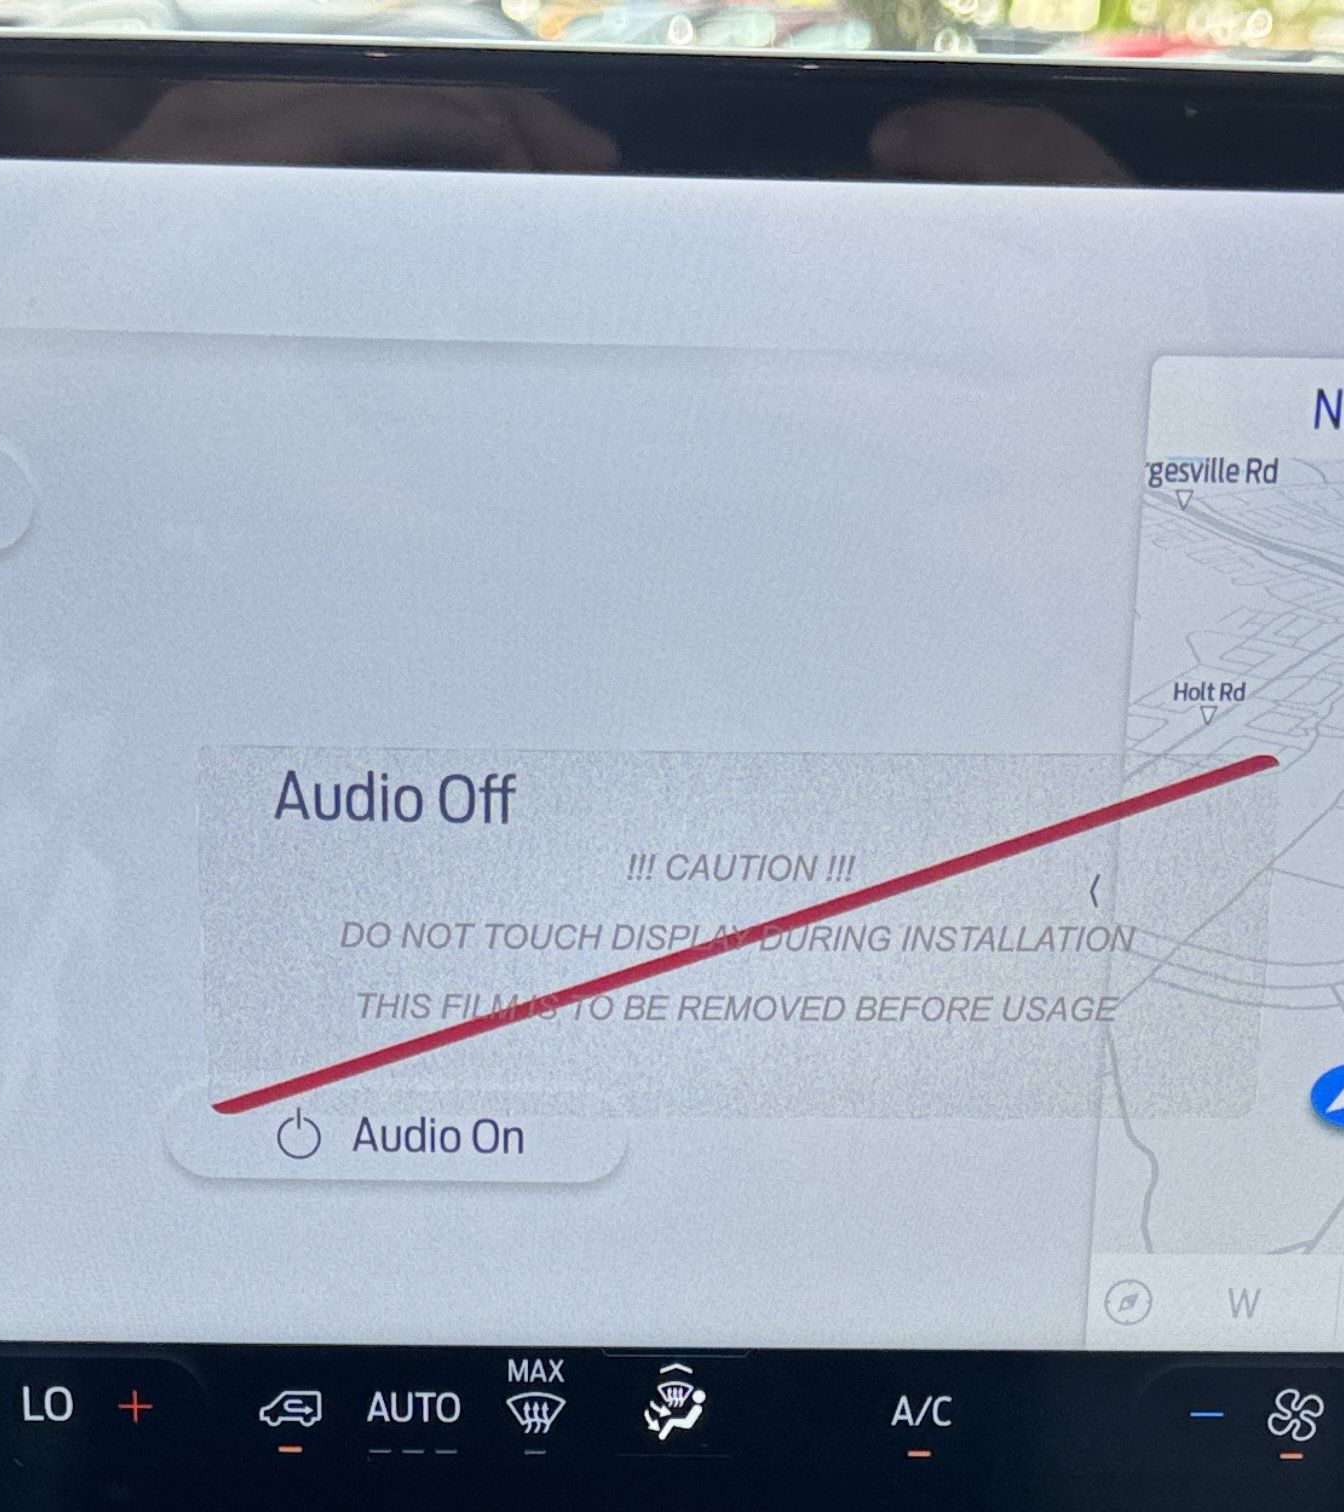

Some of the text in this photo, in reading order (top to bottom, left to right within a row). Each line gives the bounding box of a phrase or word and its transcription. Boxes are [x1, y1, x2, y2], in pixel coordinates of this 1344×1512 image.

[1145, 457, 1279, 489] gesville Rd
[1173, 681, 1246, 702] Holt Rd
[274, 769, 517, 825] Audio Off
[625, 853, 856, 882] !!! CAUTION !!!
[340, 921, 1136, 952] DO NOT TOUCH DISPLAY DURING INSTALLATION
[357, 992, 432, 1019] THIS
[441, 993, 519, 1020] FILM
[571, 994, 614, 1020] TO
[623, 995, 670, 1021] BE
[677, 995, 846, 1022] REMOVED
[856, 996, 994, 1022] BEFORE
[1002, 996, 1120, 1023] USAGE
[352, 1116, 524, 1154] Audio On
[1228, 1287, 1262, 1319] W
[507, 1358, 565, 1383] MAX
[22, 1385, 74, 1422] LO
[366, 1391, 462, 1424] AUTO
[890, 1395, 953, 1427] A/C
